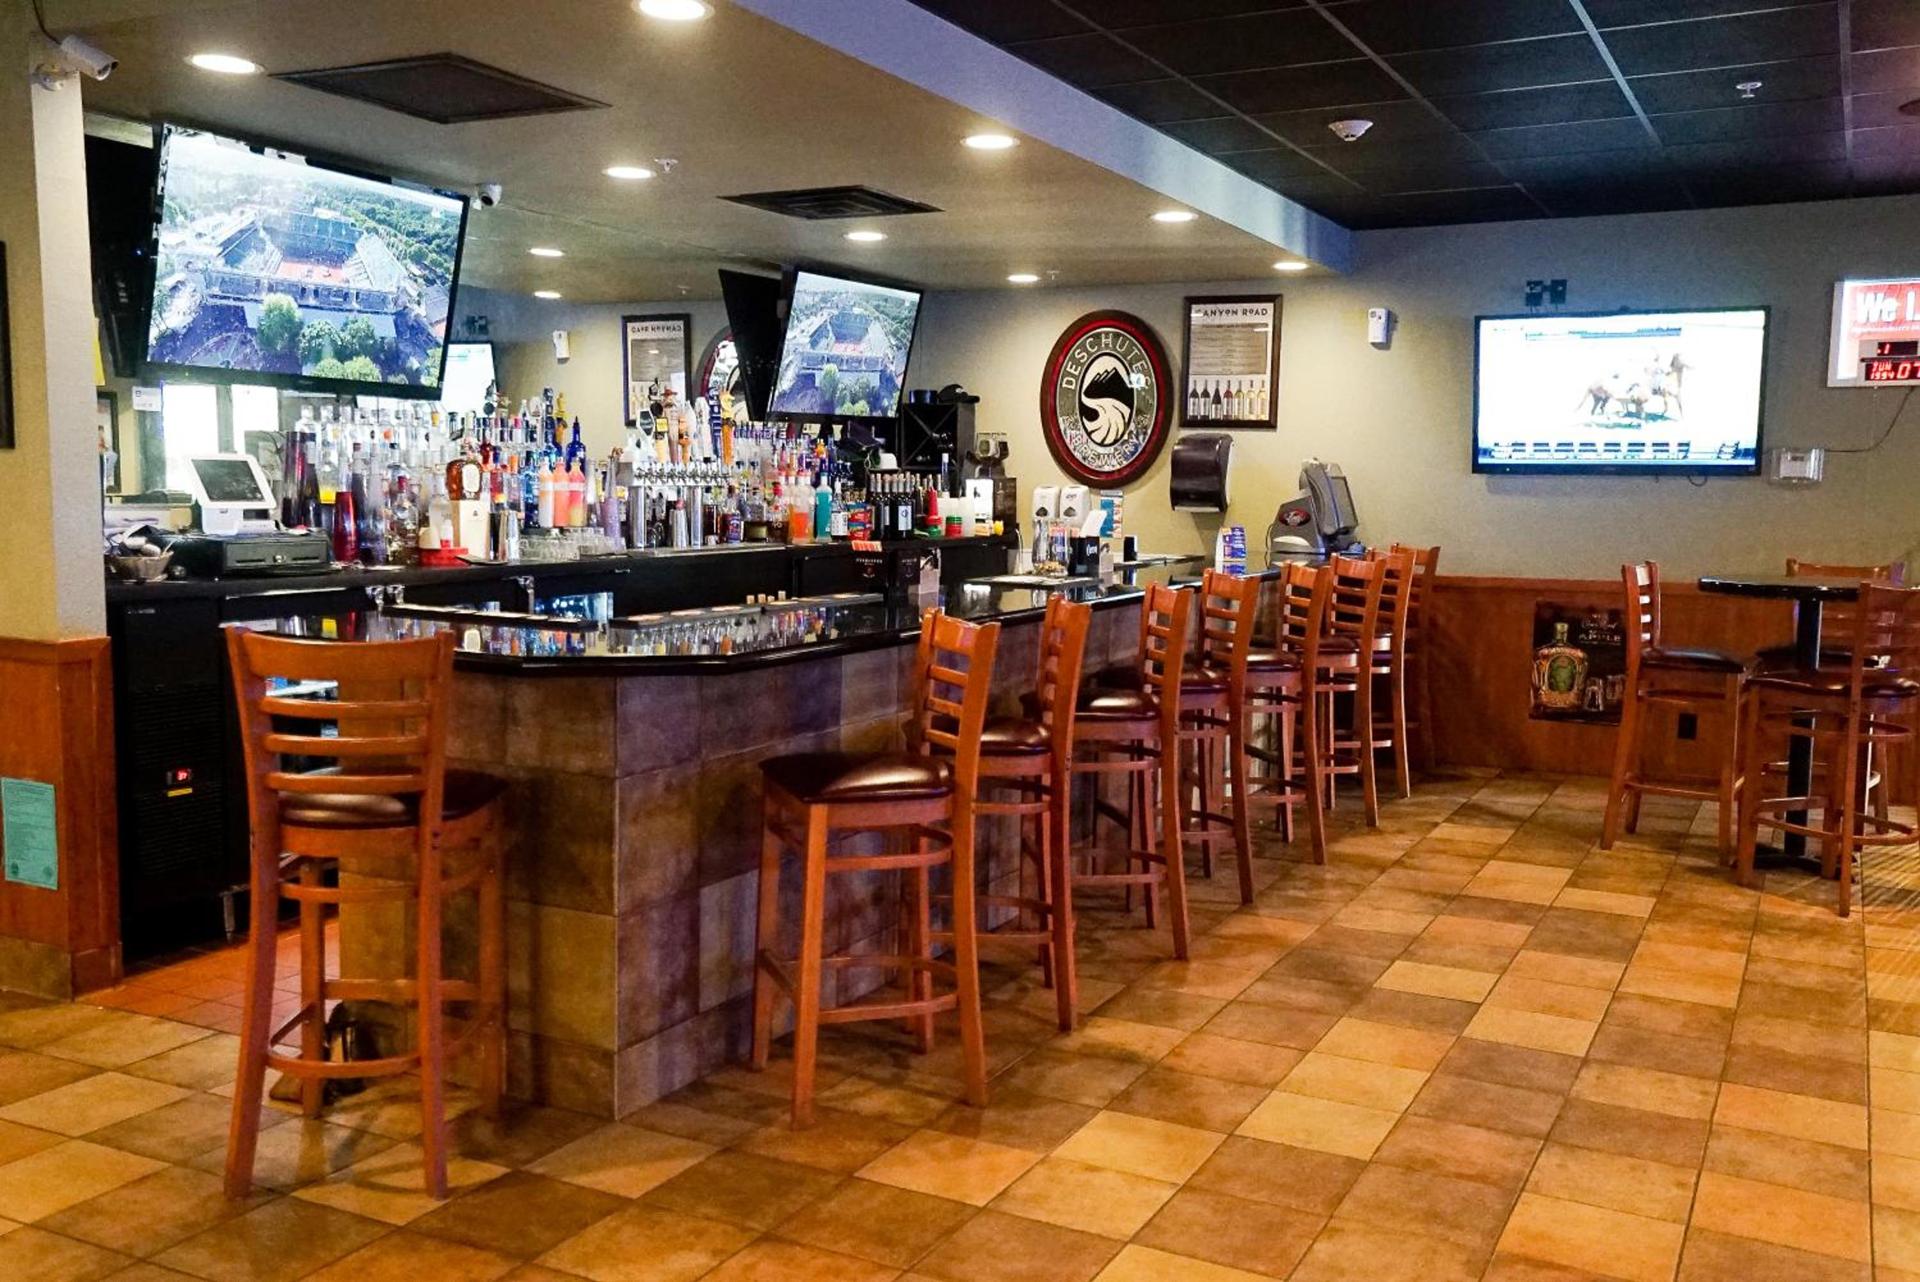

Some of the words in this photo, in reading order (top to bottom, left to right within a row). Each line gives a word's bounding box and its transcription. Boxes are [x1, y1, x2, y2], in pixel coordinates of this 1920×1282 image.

[1242, 308, 1268, 316] ROAD
[1857, 291, 1897, 322] We
[1073, 430, 1139, 466] BREWERY
